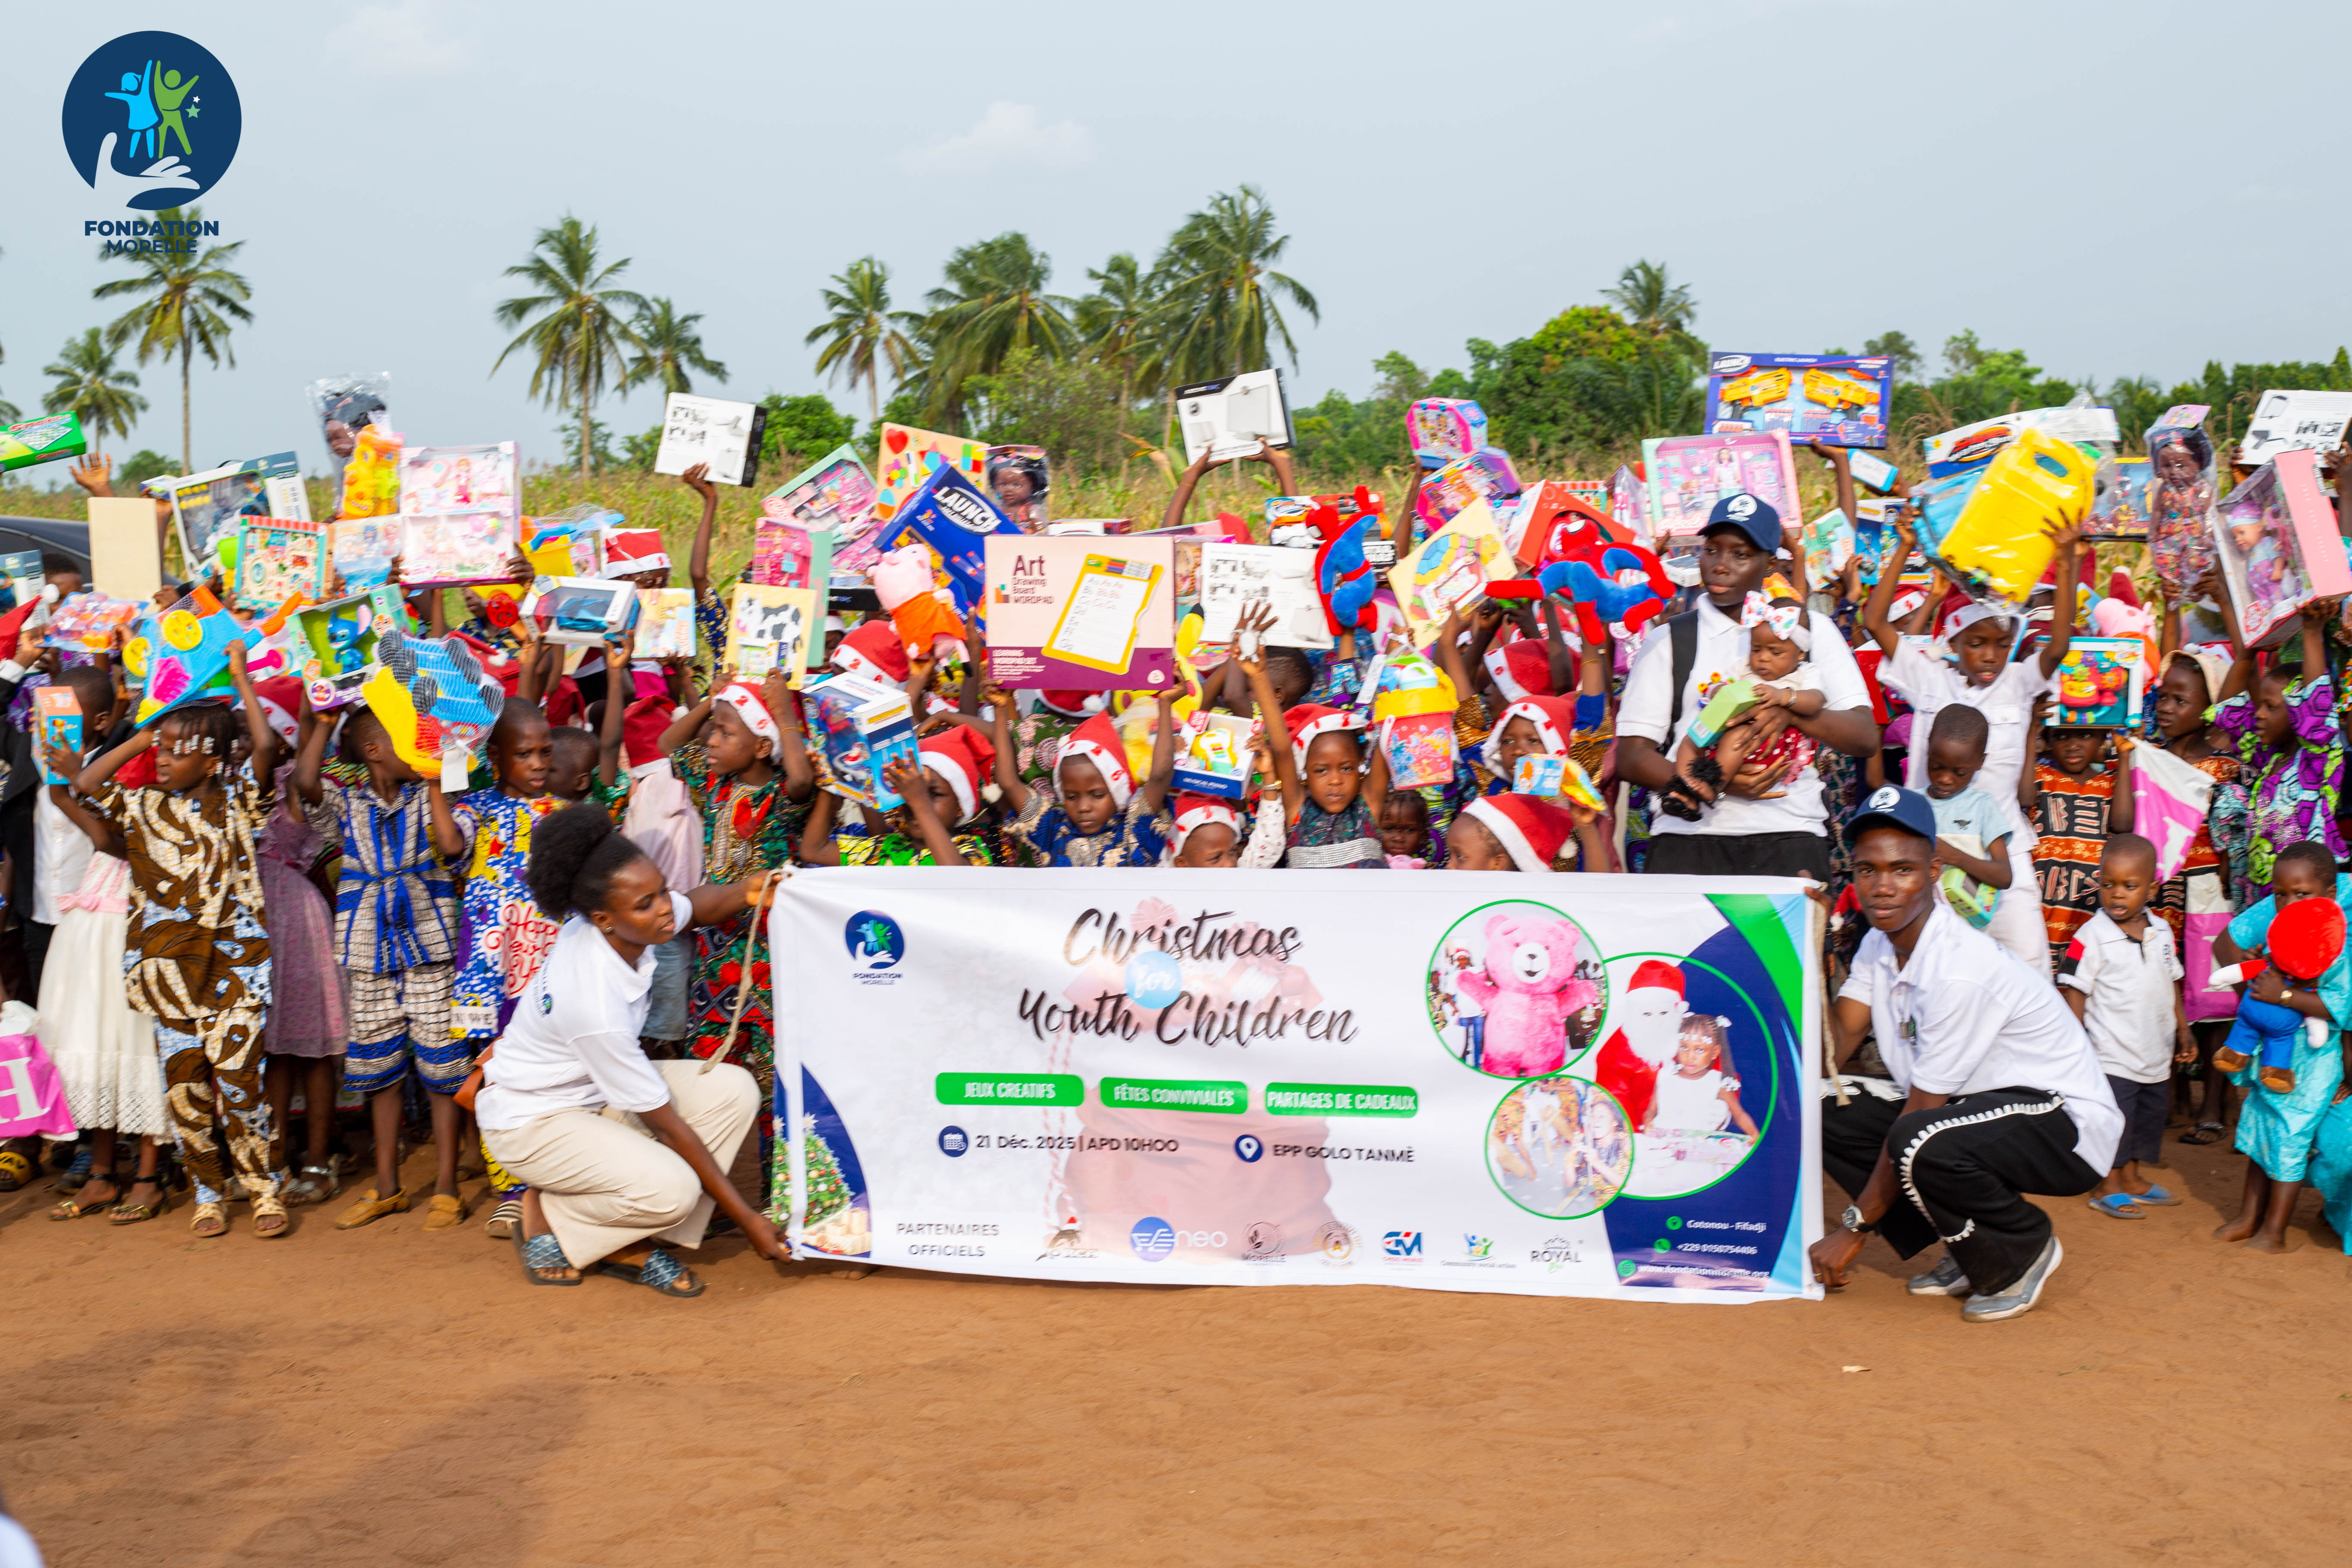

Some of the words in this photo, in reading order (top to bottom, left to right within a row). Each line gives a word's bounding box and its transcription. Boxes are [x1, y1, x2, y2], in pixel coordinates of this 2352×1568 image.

[933, 486, 1002, 533] LAUNCH
[1013, 555, 1046, 576] Art
[1012, 577, 1047, 587] Drawing
[1063, 908, 1304, 966] Christmas
[1132, 960, 1177, 999] for
[1019, 987, 1140, 1041] Youth
[1156, 991, 1361, 1048] Children
[964, 1082, 995, 1098] JEUX
[996, 1082, 1056, 1099] CREATIFS
[1114, 1083, 1150, 1102] FÊTES
[1151, 1088, 1235, 1107] CONVIVIALES
[1267, 1091, 1334, 1109] PARTAGES
[1335, 1094, 1353, 1109] DE
[1355, 1094, 1416, 1111] CADEAUX
[975, 1135, 991, 1148] 21
[996, 1134, 1032, 1149] Déc.
[1037, 1136, 1076, 1149] 2025
[1087, 1137, 1121, 1151] APD
[1273, 1144, 1303, 1157] EPP
[1305, 1145, 1351, 1160] GOLO
[1355, 1146, 1415, 1163] TANMÈ
[897, 1223, 1000, 1236] PARTENAIRES
[1686, 1220, 1729, 1230] Cotonou
[1734, 1222, 1767, 1233] Fifadji
[908, 1245, 986, 1257] OFFICIELS
[1530, 1250, 1583, 1263] ROYAL
[1676, 1243, 1700, 1252] +229
